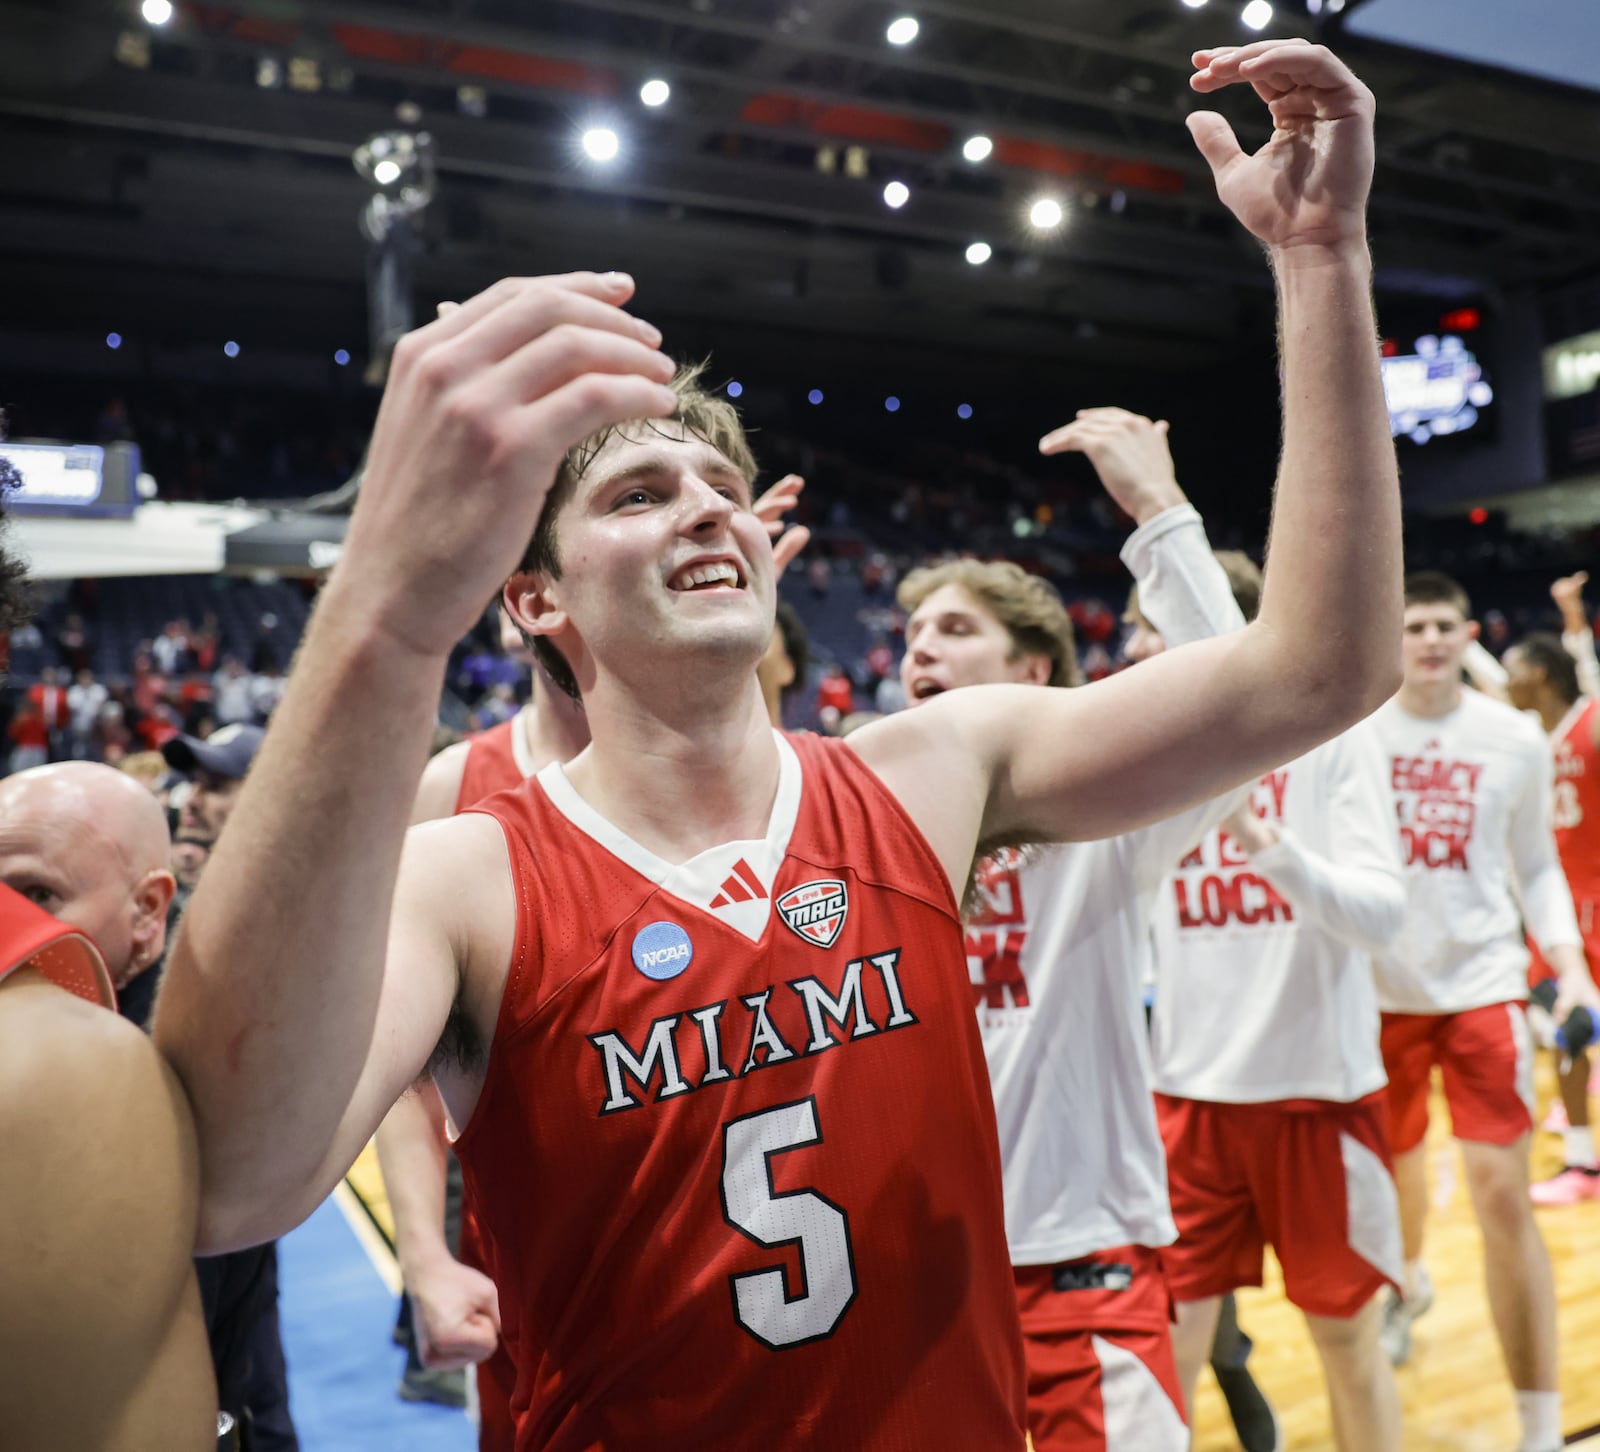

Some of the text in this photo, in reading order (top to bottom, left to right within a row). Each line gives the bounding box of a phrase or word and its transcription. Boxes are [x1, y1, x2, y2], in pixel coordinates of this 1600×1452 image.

[1391, 756, 1484, 793] EGACY
[1400, 827, 1468, 871] OCK
[787, 895, 846, 926] MAC
[641, 943, 690, 969] NCAA
[586, 947, 920, 1117] MIAMI
[718, 1094, 859, 1352] 5
